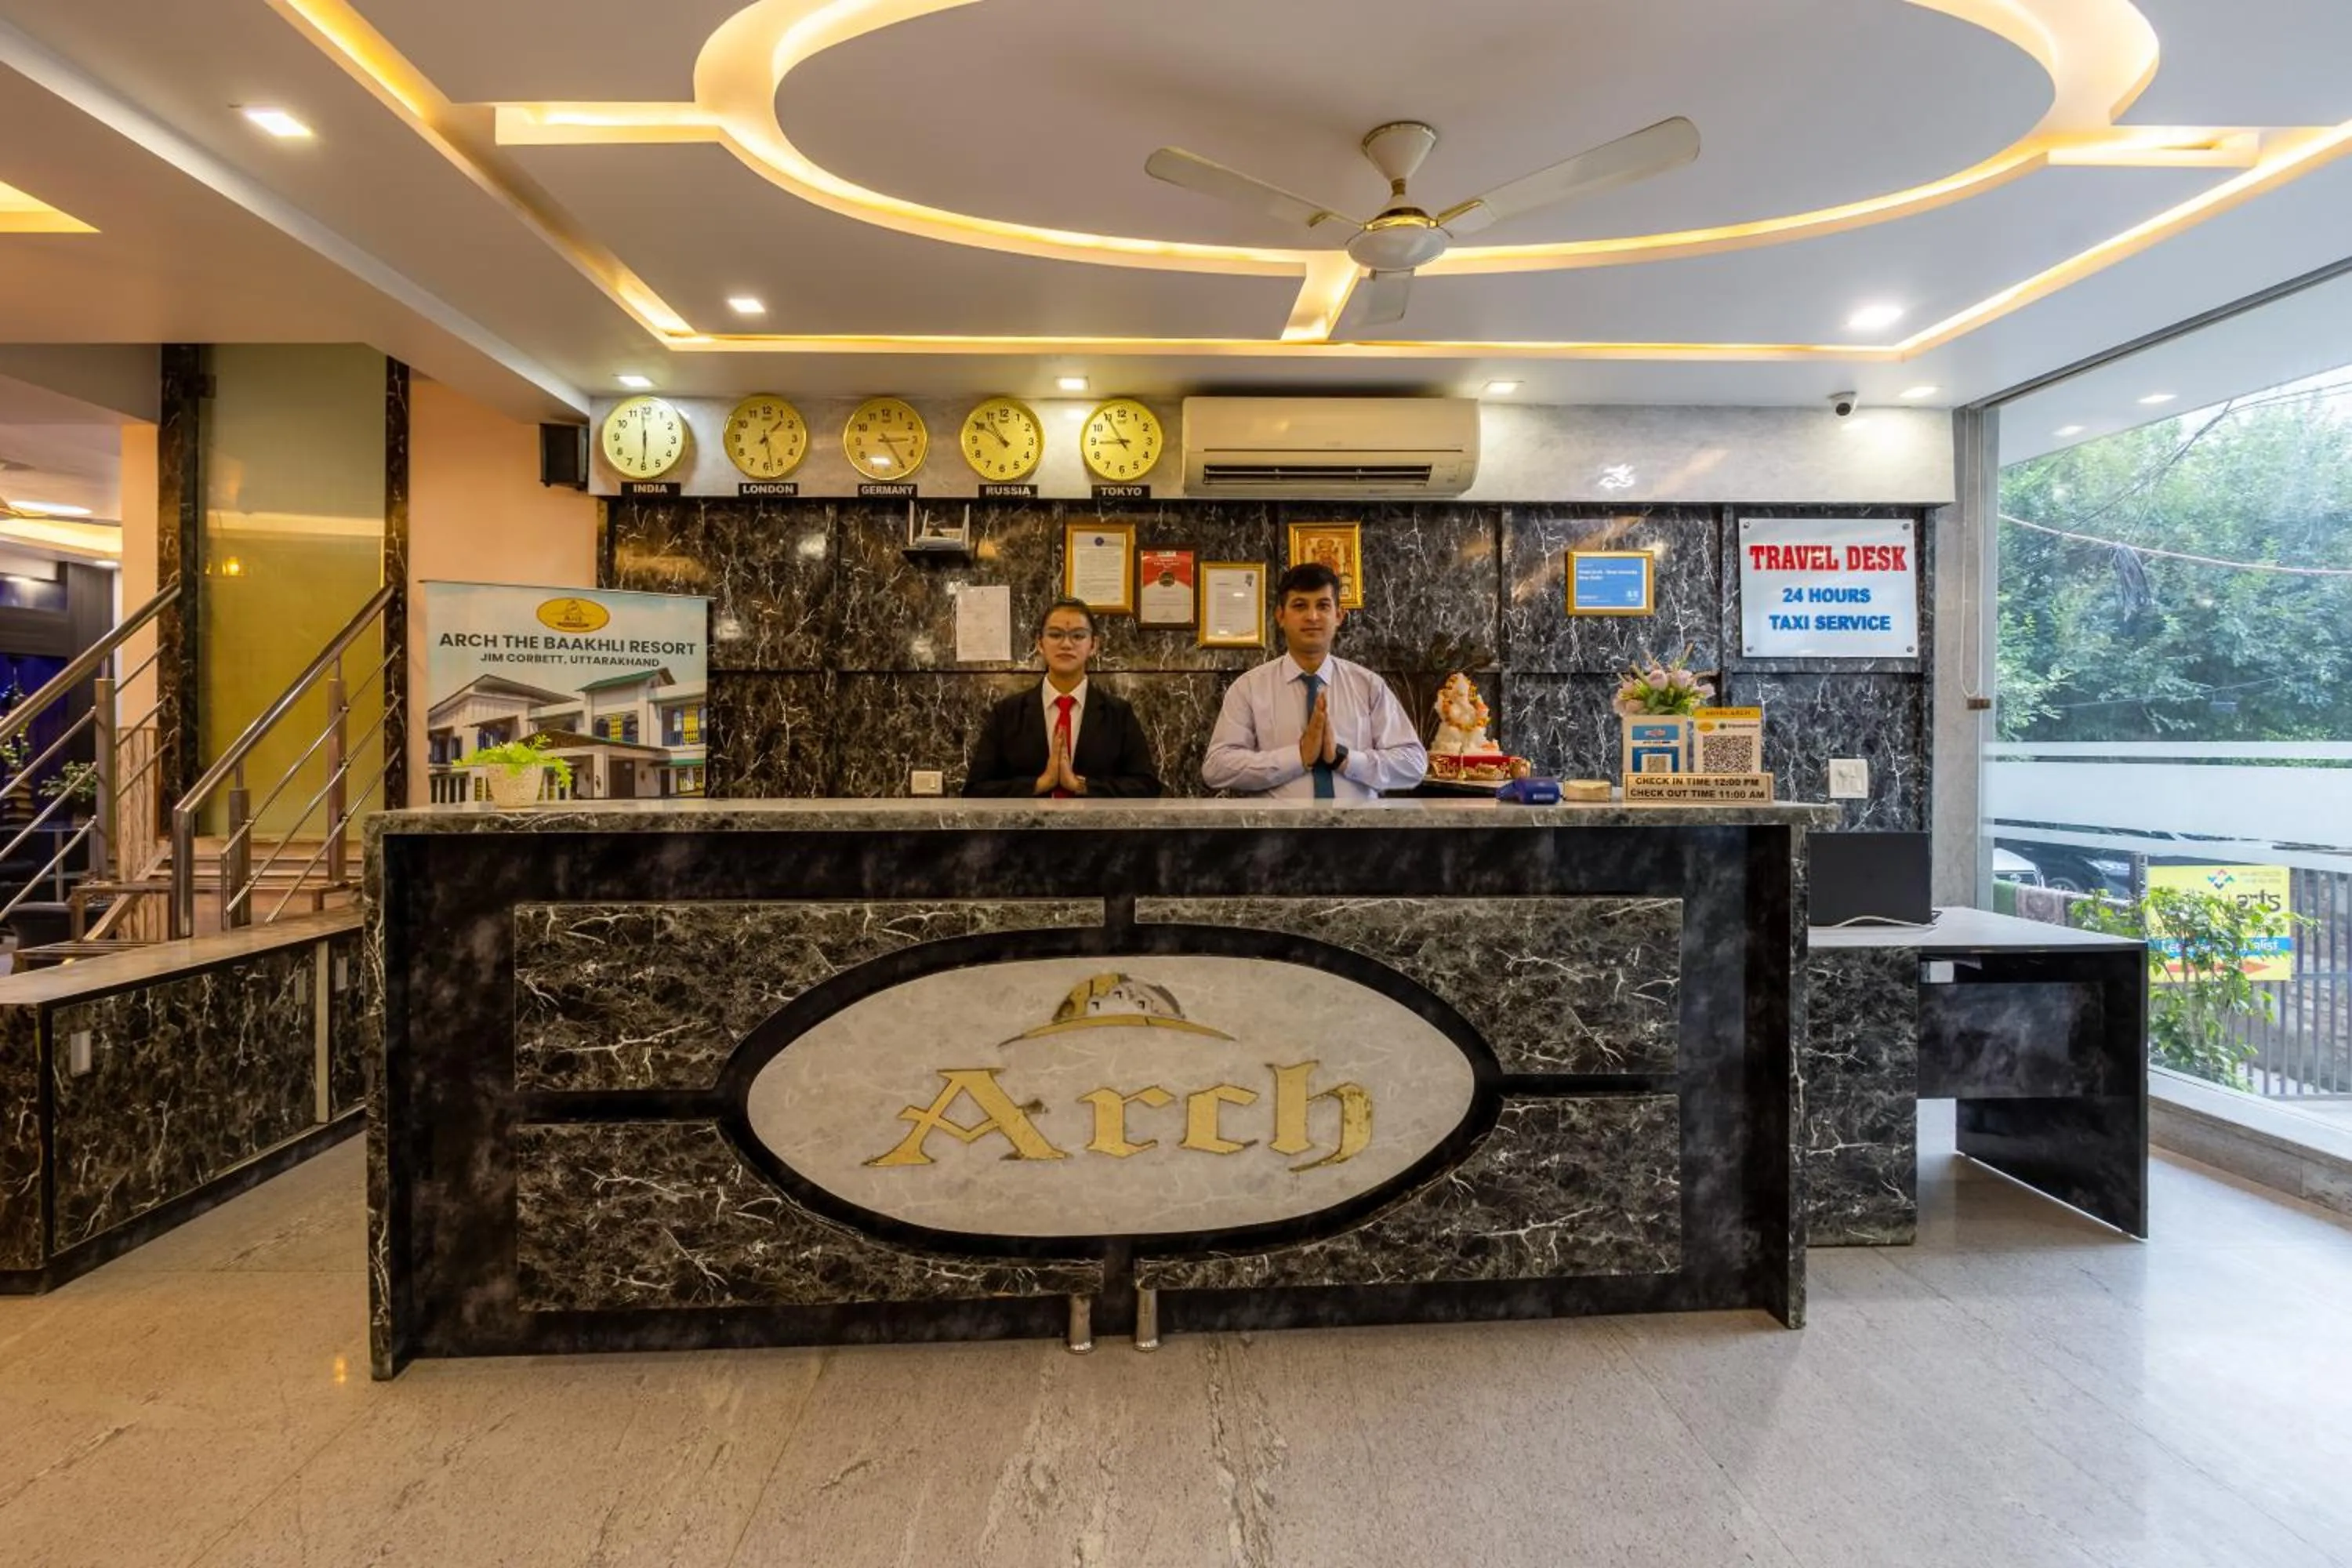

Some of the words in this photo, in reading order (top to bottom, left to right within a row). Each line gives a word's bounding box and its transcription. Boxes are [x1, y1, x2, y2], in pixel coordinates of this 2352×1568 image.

[763, 406, 772, 415] 12
[882, 408, 891, 417] 12
[1116, 409, 1126, 418] 12
[986, 412, 995, 420] 11
[618, 419, 627, 428] 10
[738, 420, 748, 429] 10
[787, 420, 794, 429] 2
[858, 423, 867, 432] 10
[1025, 423, 1030, 432] 2
[1142, 423, 1149, 432] 2
[671, 436, 677, 445] 3
[971, 435, 978, 444] 9
[1029, 437, 1034, 446] 3
[1146, 437, 1152, 445] 3
[739, 448, 745, 456] 8
[1024, 451, 1029, 459] 4
[1142, 451, 1149, 459] 4
[641, 462, 647, 470] 6
[763, 462, 770, 470] 6
[777, 458, 783, 466] 5
[1014, 461, 1019, 470] 5
[1133, 461, 1138, 470] 5
[1119, 465, 1125, 474] 6
[633, 485, 667, 493] INDIA
[742, 485, 794, 494] LONDON
[862, 485, 913, 495] GERMANY
[985, 485, 1031, 495] RUSSIA
[1100, 487, 1142, 495] TOKYO
[1748, 544, 1839, 571] TRAVEL
[1846, 545, 1907, 571] DESK
[1782, 588, 1803, 603] 24
[1809, 588, 1871, 603] HOURS
[1769, 615, 1809, 630] TAXI
[1815, 615, 1891, 630] SERVICE
[439, 633, 498, 648] ARCH
[503, 635, 539, 650] THE
[543, 637, 625, 652] BAAKHLI
[630, 640, 697, 655] RESORT
[480, 653, 504, 662] JIM
[506, 653, 567, 665] CORBETT,
[570, 655, 659, 667] UTTARAKHAND
[1635, 777, 1669, 786] CHECK
[1686, 778, 1711, 786] TIME
[1715, 778, 1741, 786] 12:00
[1630, 788, 1664, 797] CHECK
[1667, 789, 1687, 797] OUT
[1692, 789, 1716, 798] TIME
[1719, 790, 1746, 799] 11:00
[1749, 790, 1765, 799] AM
[862, 1059, 1375, 1172] Arch
